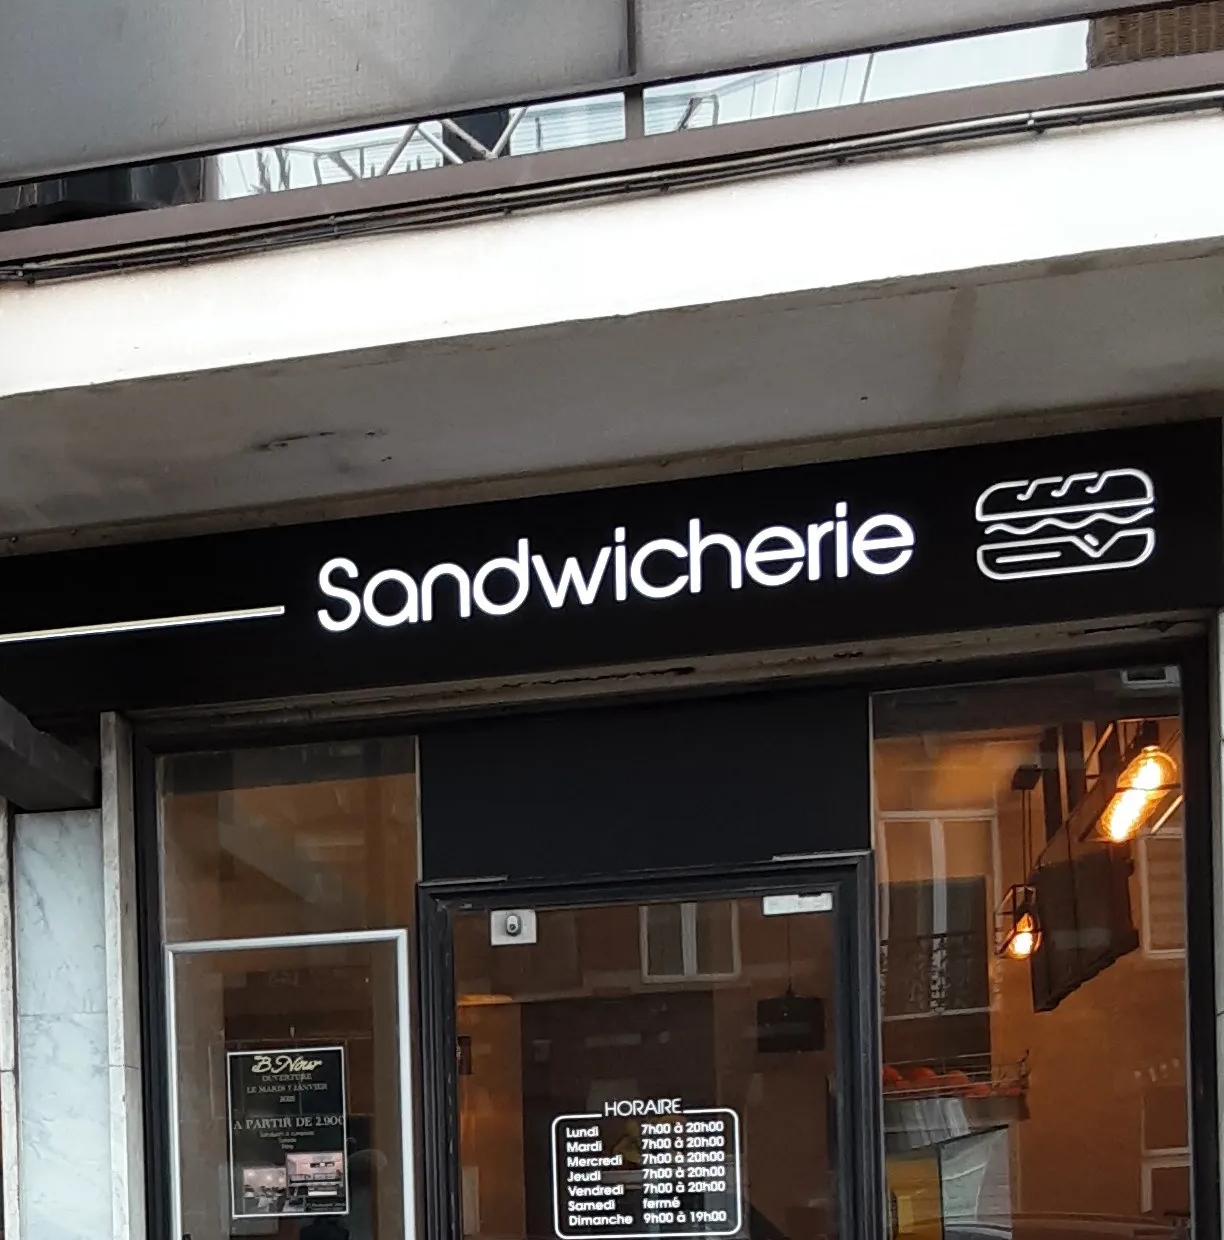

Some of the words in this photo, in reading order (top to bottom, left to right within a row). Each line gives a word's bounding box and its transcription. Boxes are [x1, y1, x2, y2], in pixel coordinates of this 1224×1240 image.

[317, 501, 916, 633] Sandwicherie
[246, 1086, 257, 1094] LE
[604, 1098, 683, 1117] HORAIRE
[234, 1120, 243, 1130] A
[246, 1117, 292, 1129] PARTIR
[296, 1116, 313, 1127] DE
[566, 1126, 599, 1138] Lundi
[641, 1123, 671, 1135] 7h00
[674, 1122, 683, 1134] à
[686, 1121, 724, 1133] 20h00
[566, 1141, 602, 1153] Mardi
[641, 1138, 671, 1150] 7h00
[674, 1137, 684, 1149] à
[686, 1136, 724, 1148] 20h00
[567, 1155, 623, 1168] Mercredi
[642, 1153, 672, 1165] 7h00
[675, 1152, 684, 1164] à
[686, 1151, 725, 1163] 20h00
[567, 1171, 601, 1182] Jeudi
[642, 1168, 672, 1180] 7h00
[675, 1167, 684, 1178] à
[687, 1166, 725, 1178] 20h00
[567, 1185, 624, 1197] Vendredi
[643, 1183, 673, 1194] 7h00
[675, 1182, 685, 1193] à
[687, 1181, 725, 1193] 20h00
[568, 1199, 615, 1211] Samedi
[643, 1196, 681, 1209] fermé
[568, 1214, 633, 1226] Dimanche
[643, 1212, 674, 1224] 9h00
[676, 1211, 686, 1223] à
[690, 1210, 726, 1222] 19h00
